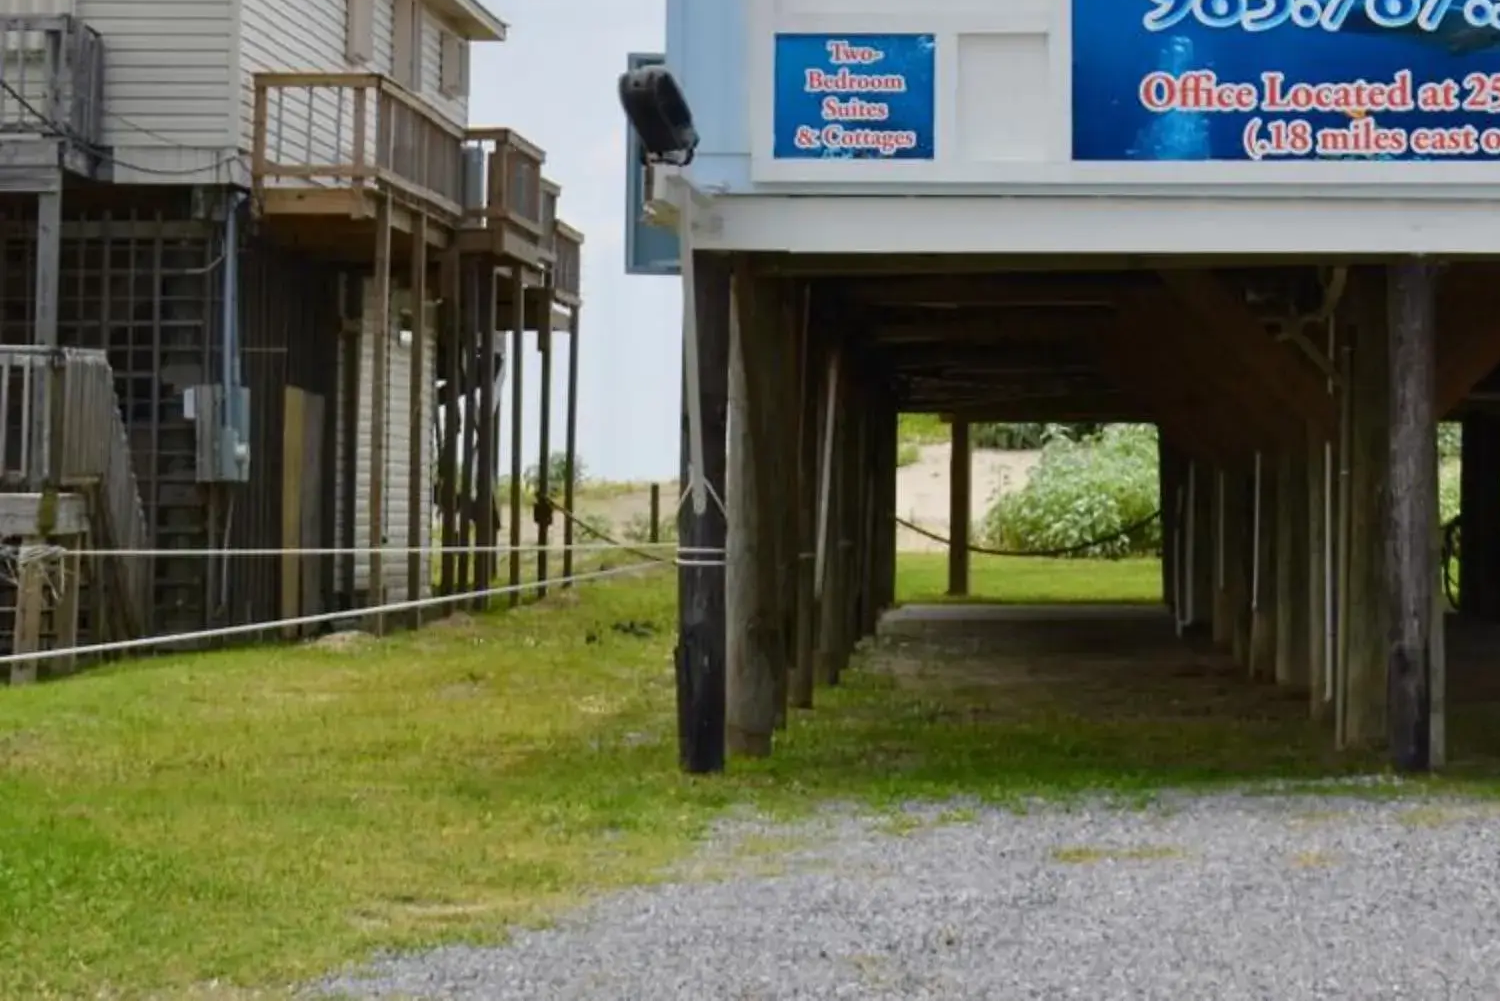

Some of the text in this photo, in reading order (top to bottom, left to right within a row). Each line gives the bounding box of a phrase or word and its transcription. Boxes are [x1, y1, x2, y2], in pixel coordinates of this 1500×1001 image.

[806, 69, 906, 91] Bedroom
[1141, 72, 1254, 110] Office
[1264, 72, 1411, 110] Located
[1421, 76, 1456, 110] at
[822, 97, 888, 119] Suites
[795, 125, 916, 153] & Cottages
[1244, 119, 1308, 158] (.18
[1319, 120, 1404, 153] miles
[1411, 125, 1474, 153] east
